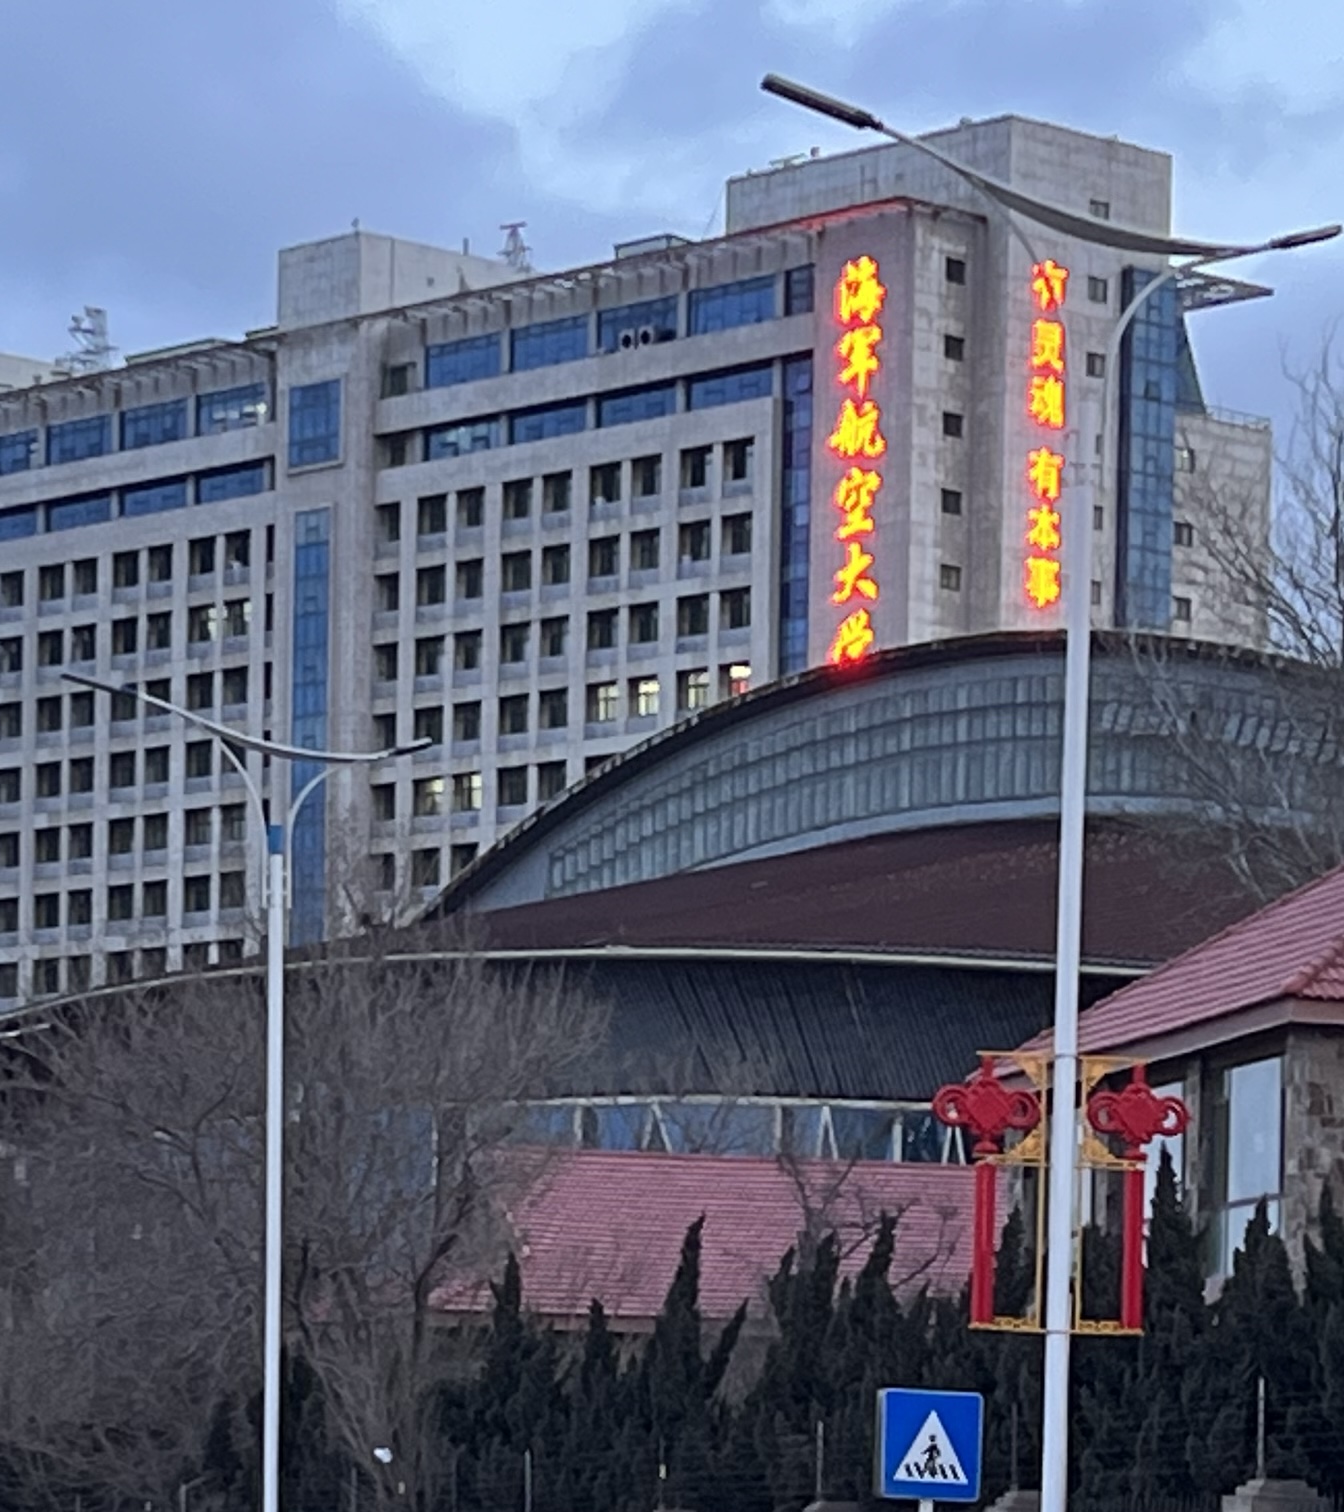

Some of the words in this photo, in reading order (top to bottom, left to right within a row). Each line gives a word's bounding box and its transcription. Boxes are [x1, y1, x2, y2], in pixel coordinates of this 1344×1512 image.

[829, 255, 886, 664] 海军航空大学
[1026, 447, 1064, 607] 有本事
